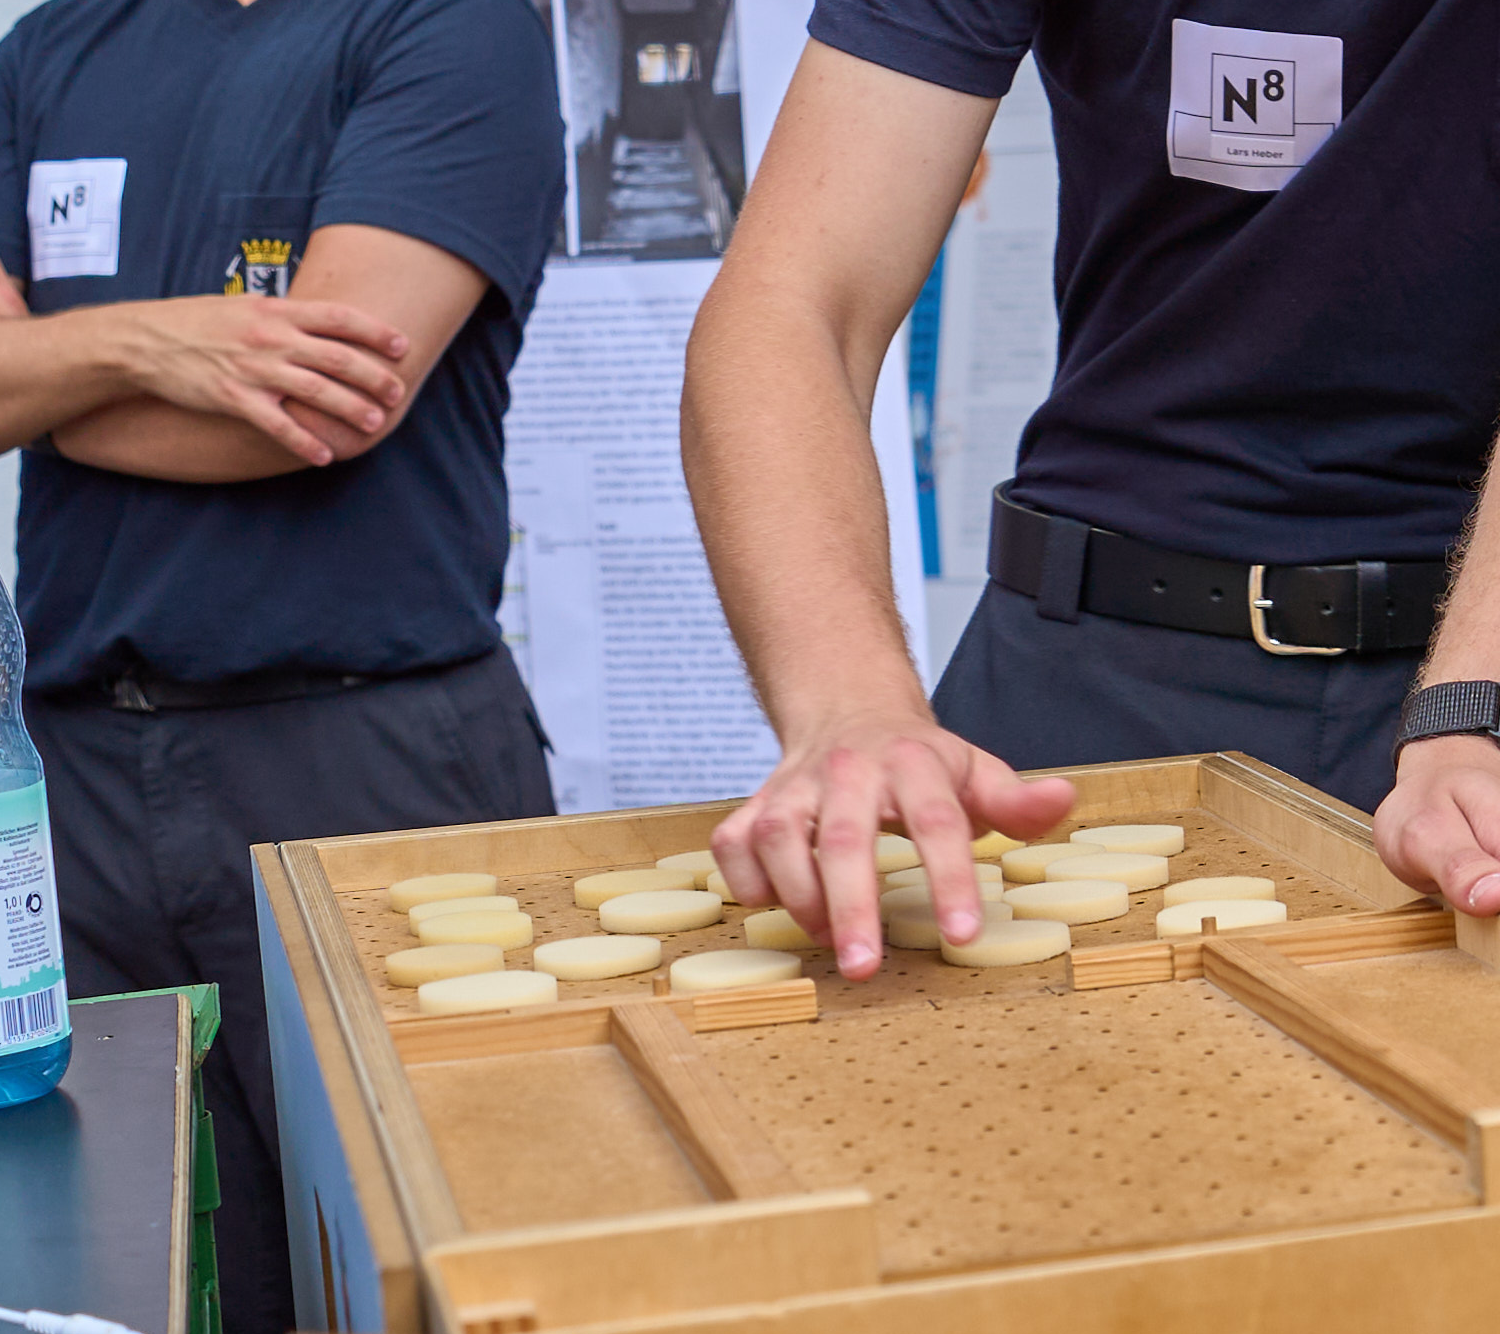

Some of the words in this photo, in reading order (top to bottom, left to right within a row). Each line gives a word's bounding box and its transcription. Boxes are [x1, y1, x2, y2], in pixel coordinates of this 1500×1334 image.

[1227, 147, 1249, 157] Lars
[1252, 150, 1284, 160] Heber
[4, 896, 17, 910] 1,0
